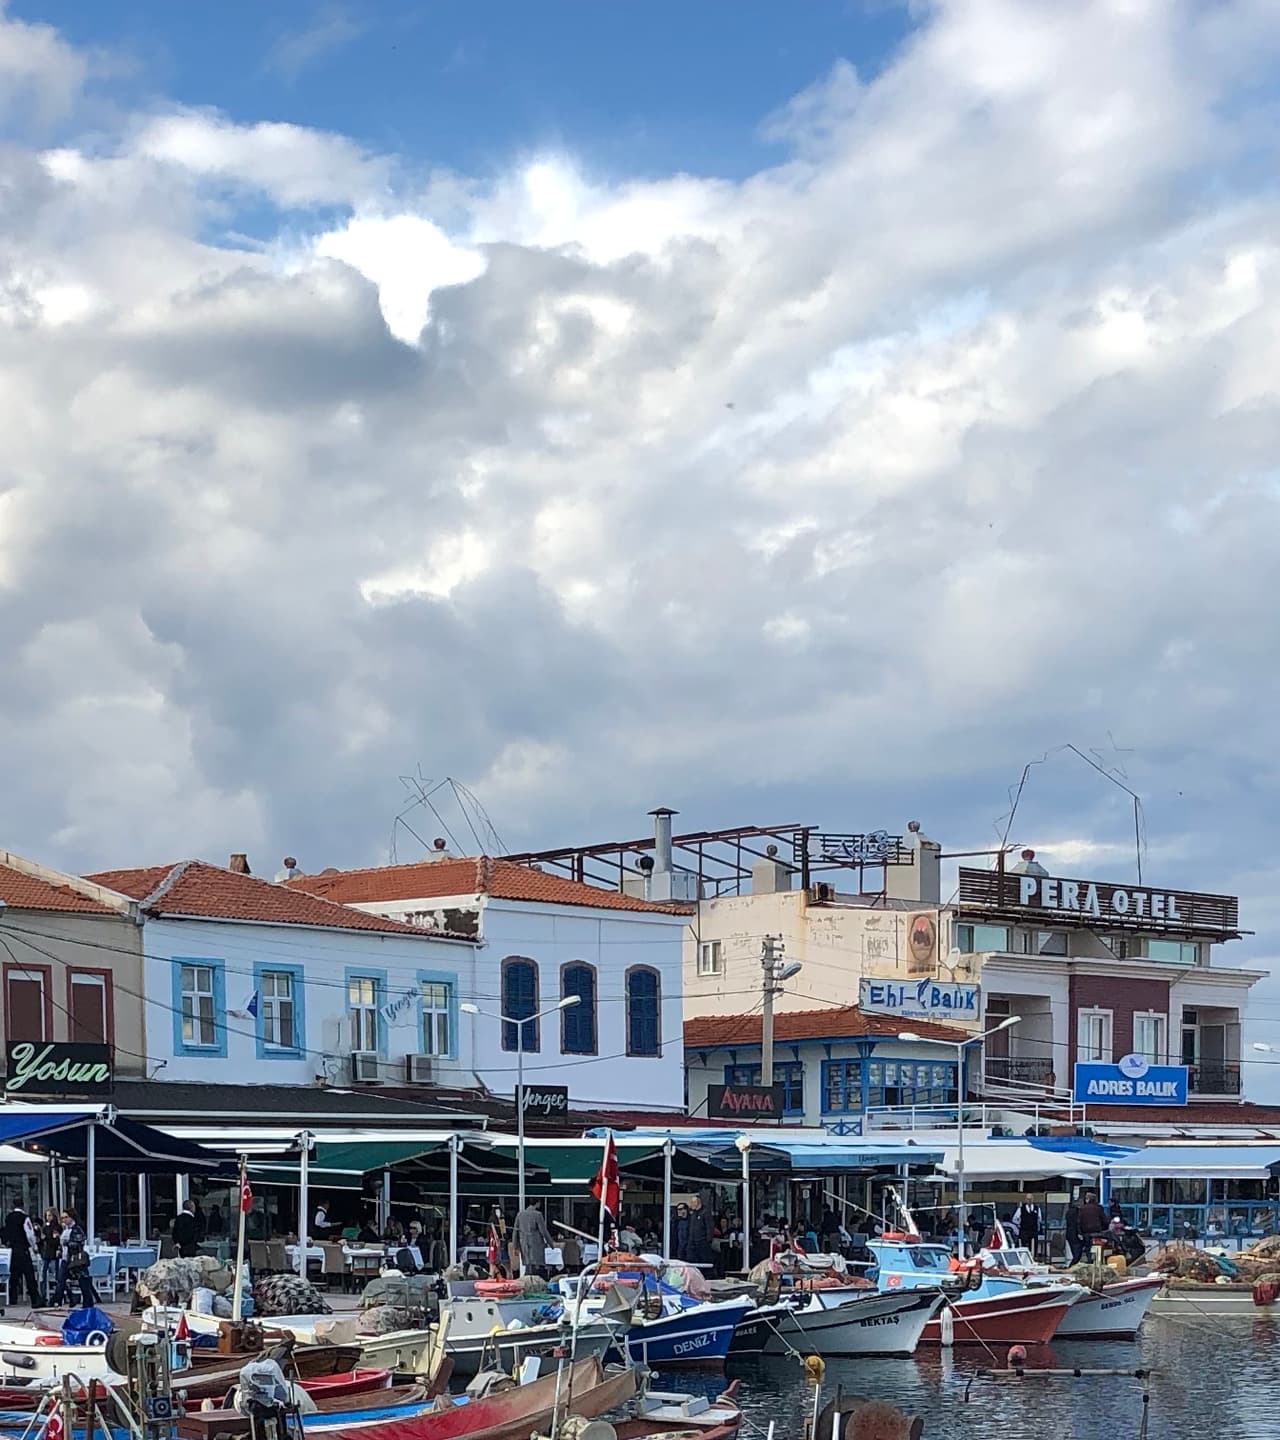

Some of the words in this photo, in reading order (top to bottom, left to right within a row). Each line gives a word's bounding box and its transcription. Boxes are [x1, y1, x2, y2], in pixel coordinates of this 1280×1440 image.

[1020, 876, 1101, 918] PERA
[1112, 889, 1181, 920] OTEL
[6, 1042, 110, 1090] Yosun
[1087, 1079, 1134, 1096] ADRES
[1136, 1081, 1178, 1097] BALIK
